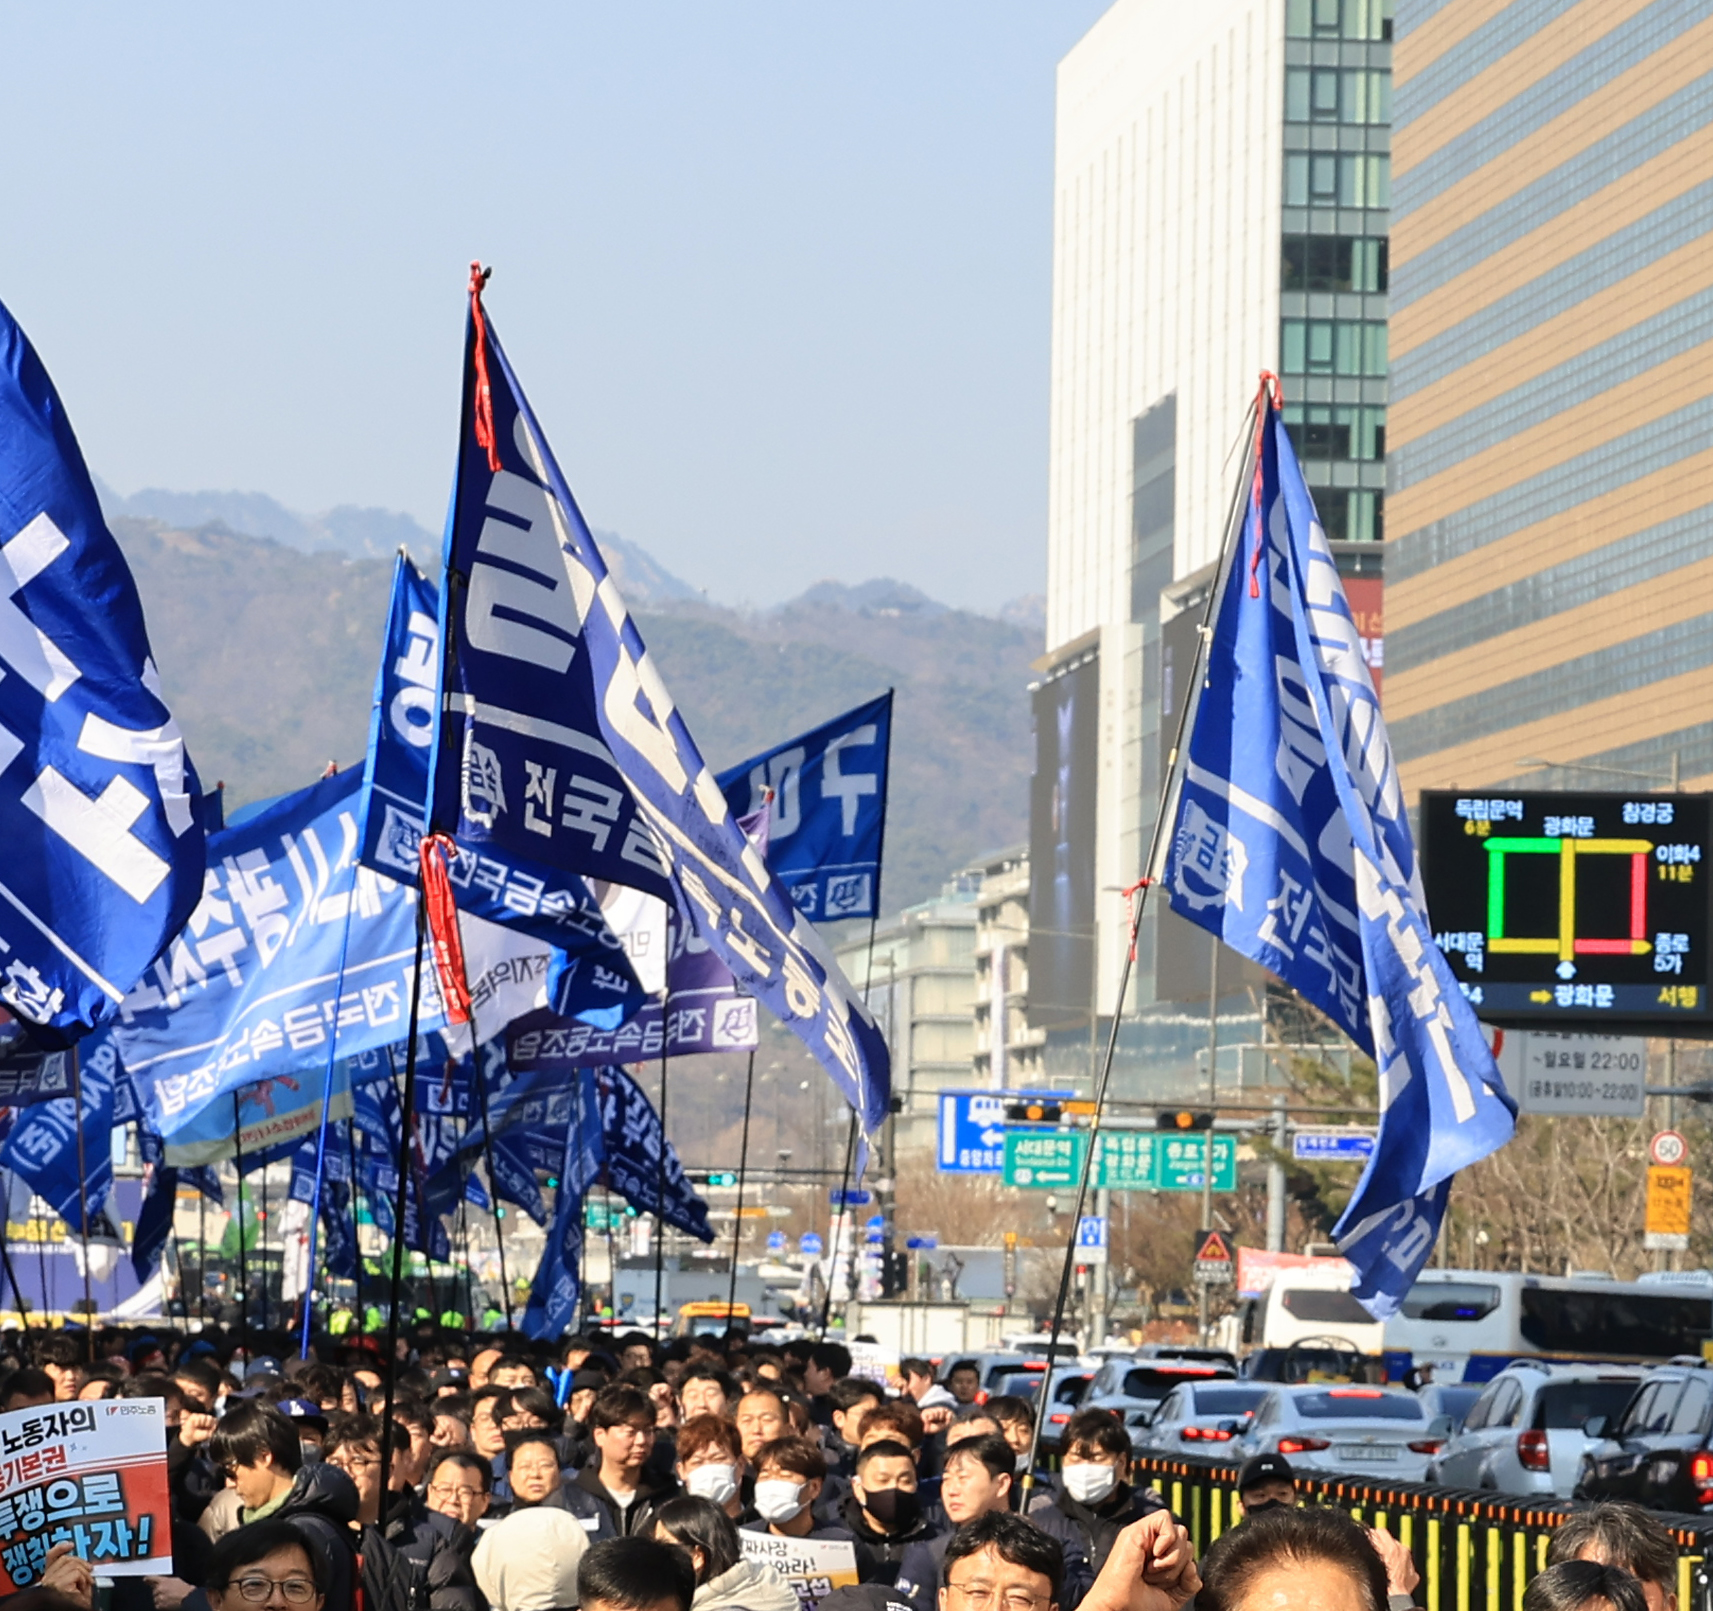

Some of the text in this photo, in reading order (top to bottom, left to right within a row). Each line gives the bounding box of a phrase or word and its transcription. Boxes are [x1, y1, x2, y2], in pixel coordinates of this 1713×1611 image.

[1455, 798, 1524, 820] 독립문역
[1543, 816, 1595, 838] 광화문
[1555, 984, 1615, 1008] 광화문
[1591, 1051, 1640, 1071] 22:00
[120, 1403, 157, 1417] 민주노총
[3, 1405, 99, 1454] 노동자의
